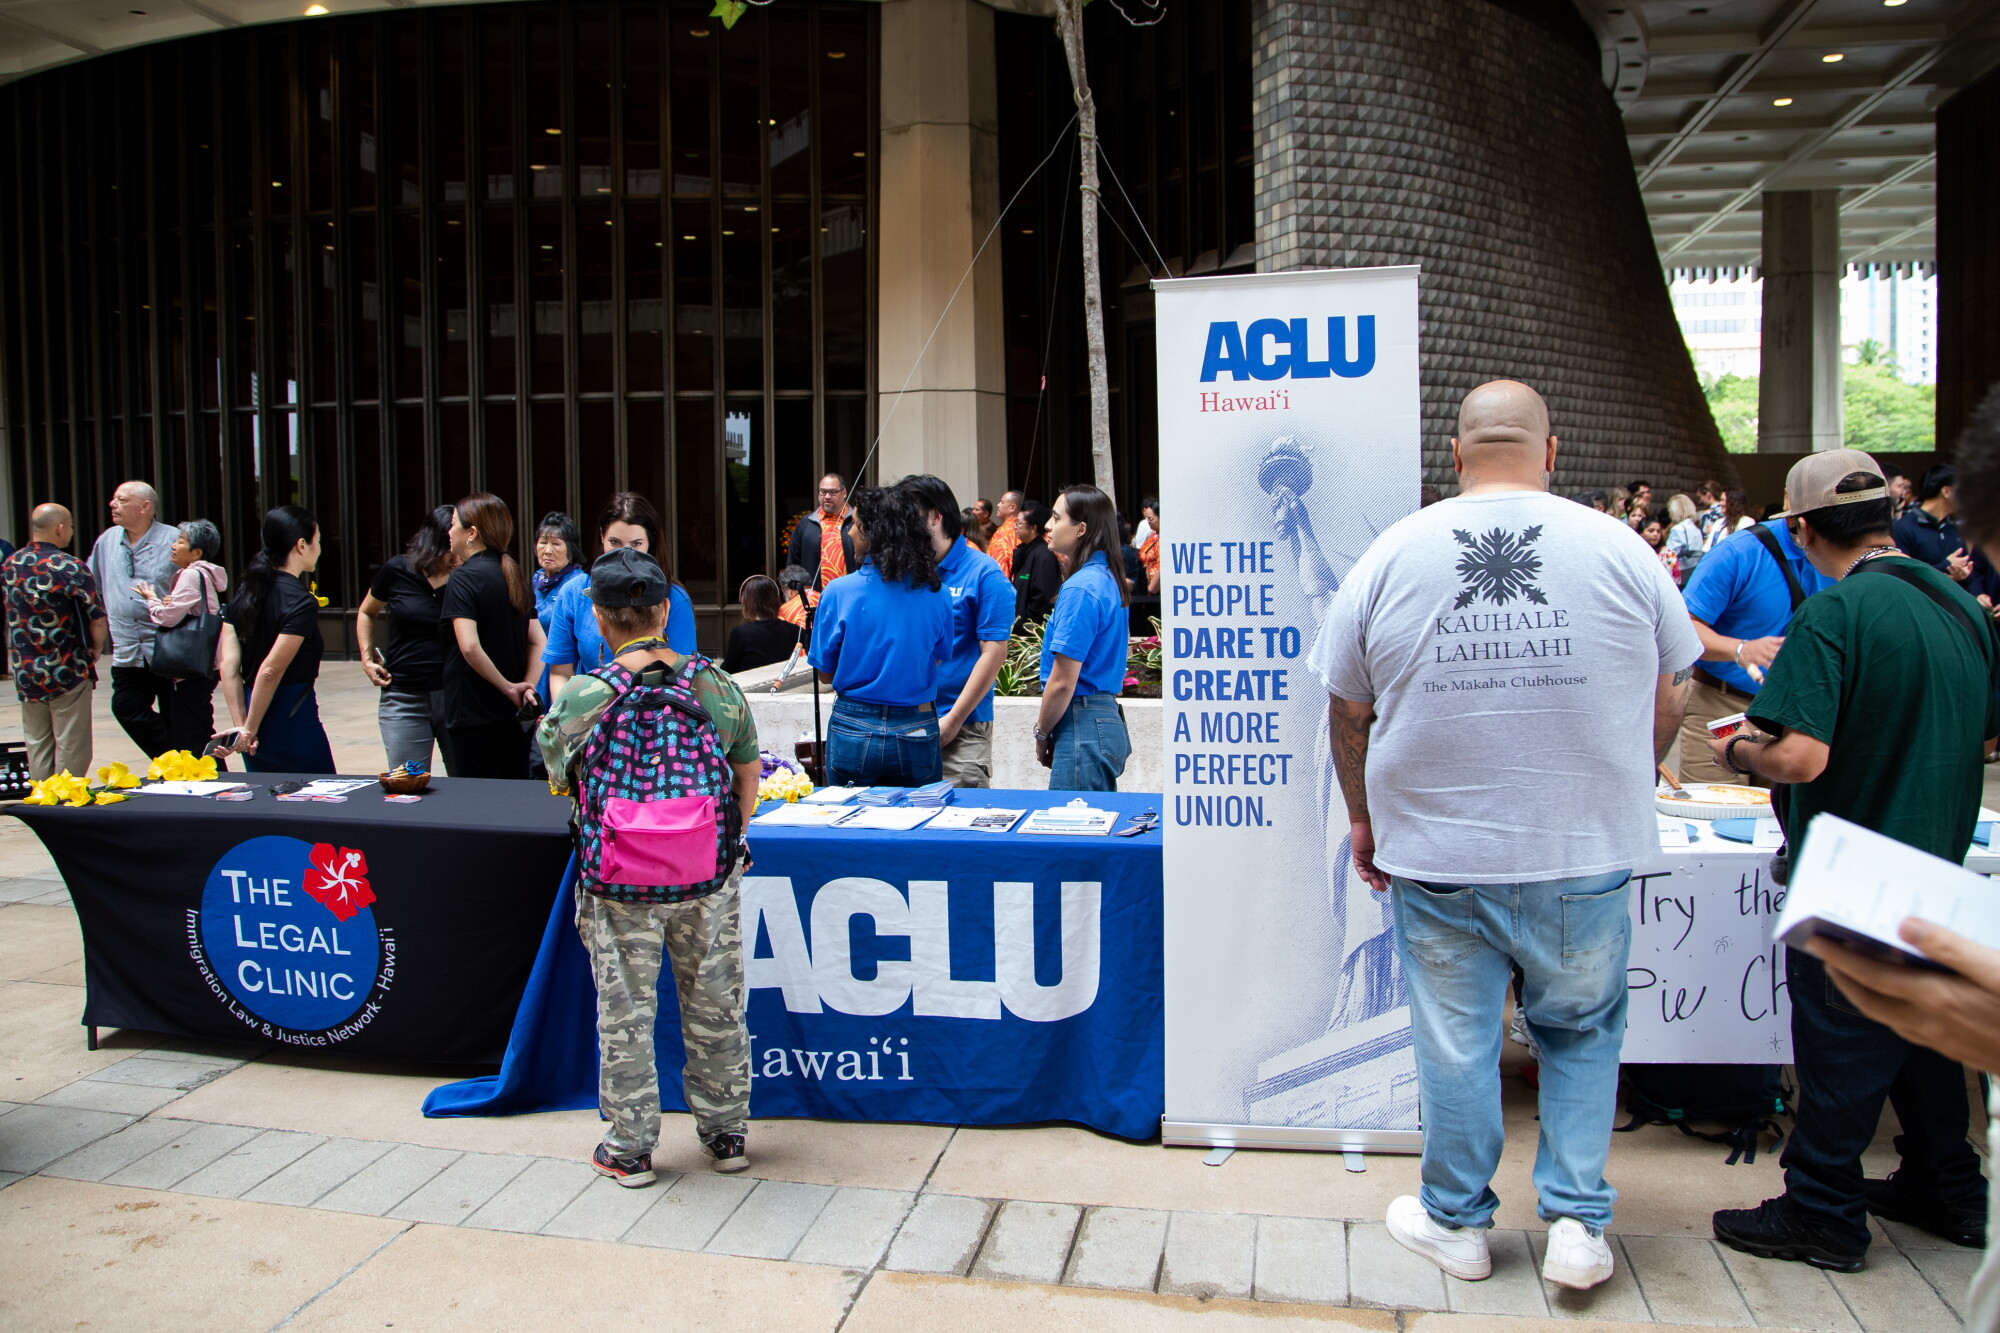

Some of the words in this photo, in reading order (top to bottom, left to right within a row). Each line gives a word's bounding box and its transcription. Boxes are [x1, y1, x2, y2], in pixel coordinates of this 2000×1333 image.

[1200, 315, 1376, 382] ACLU
[1171, 542, 1213, 574] WE
[1220, 541, 1275, 573] THE
[1173, 584, 1275, 616] PEOPLE
[1435, 609, 1570, 636] KAUHALE
[1173, 627, 1254, 659] DARE
[1260, 626, 1301, 659] TO
[1434, 638, 1573, 664] LAHILAHI
[1173, 669, 1288, 701] CREATE
[1423, 682, 1448, 693] The
[1510, 674, 1588, 688] Clubhouse
[1173, 712, 1192, 742] A
[1201, 711, 1280, 743] MORE
[1175, 753, 1293, 785] PERFECT
[1175, 795, 1273, 827] UNION.
[1630, 871, 1694, 951] Try
[1734, 868, 1787, 916] the
[739, 876, 1102, 1022] ACLU
[186, 909, 228, 1003] Immigration
[228, 999, 259, 1029] Law
[262, 1023, 273, 1038] &
[276, 1028, 327, 1047] Justice
[326, 1002, 382, 1044] Network
